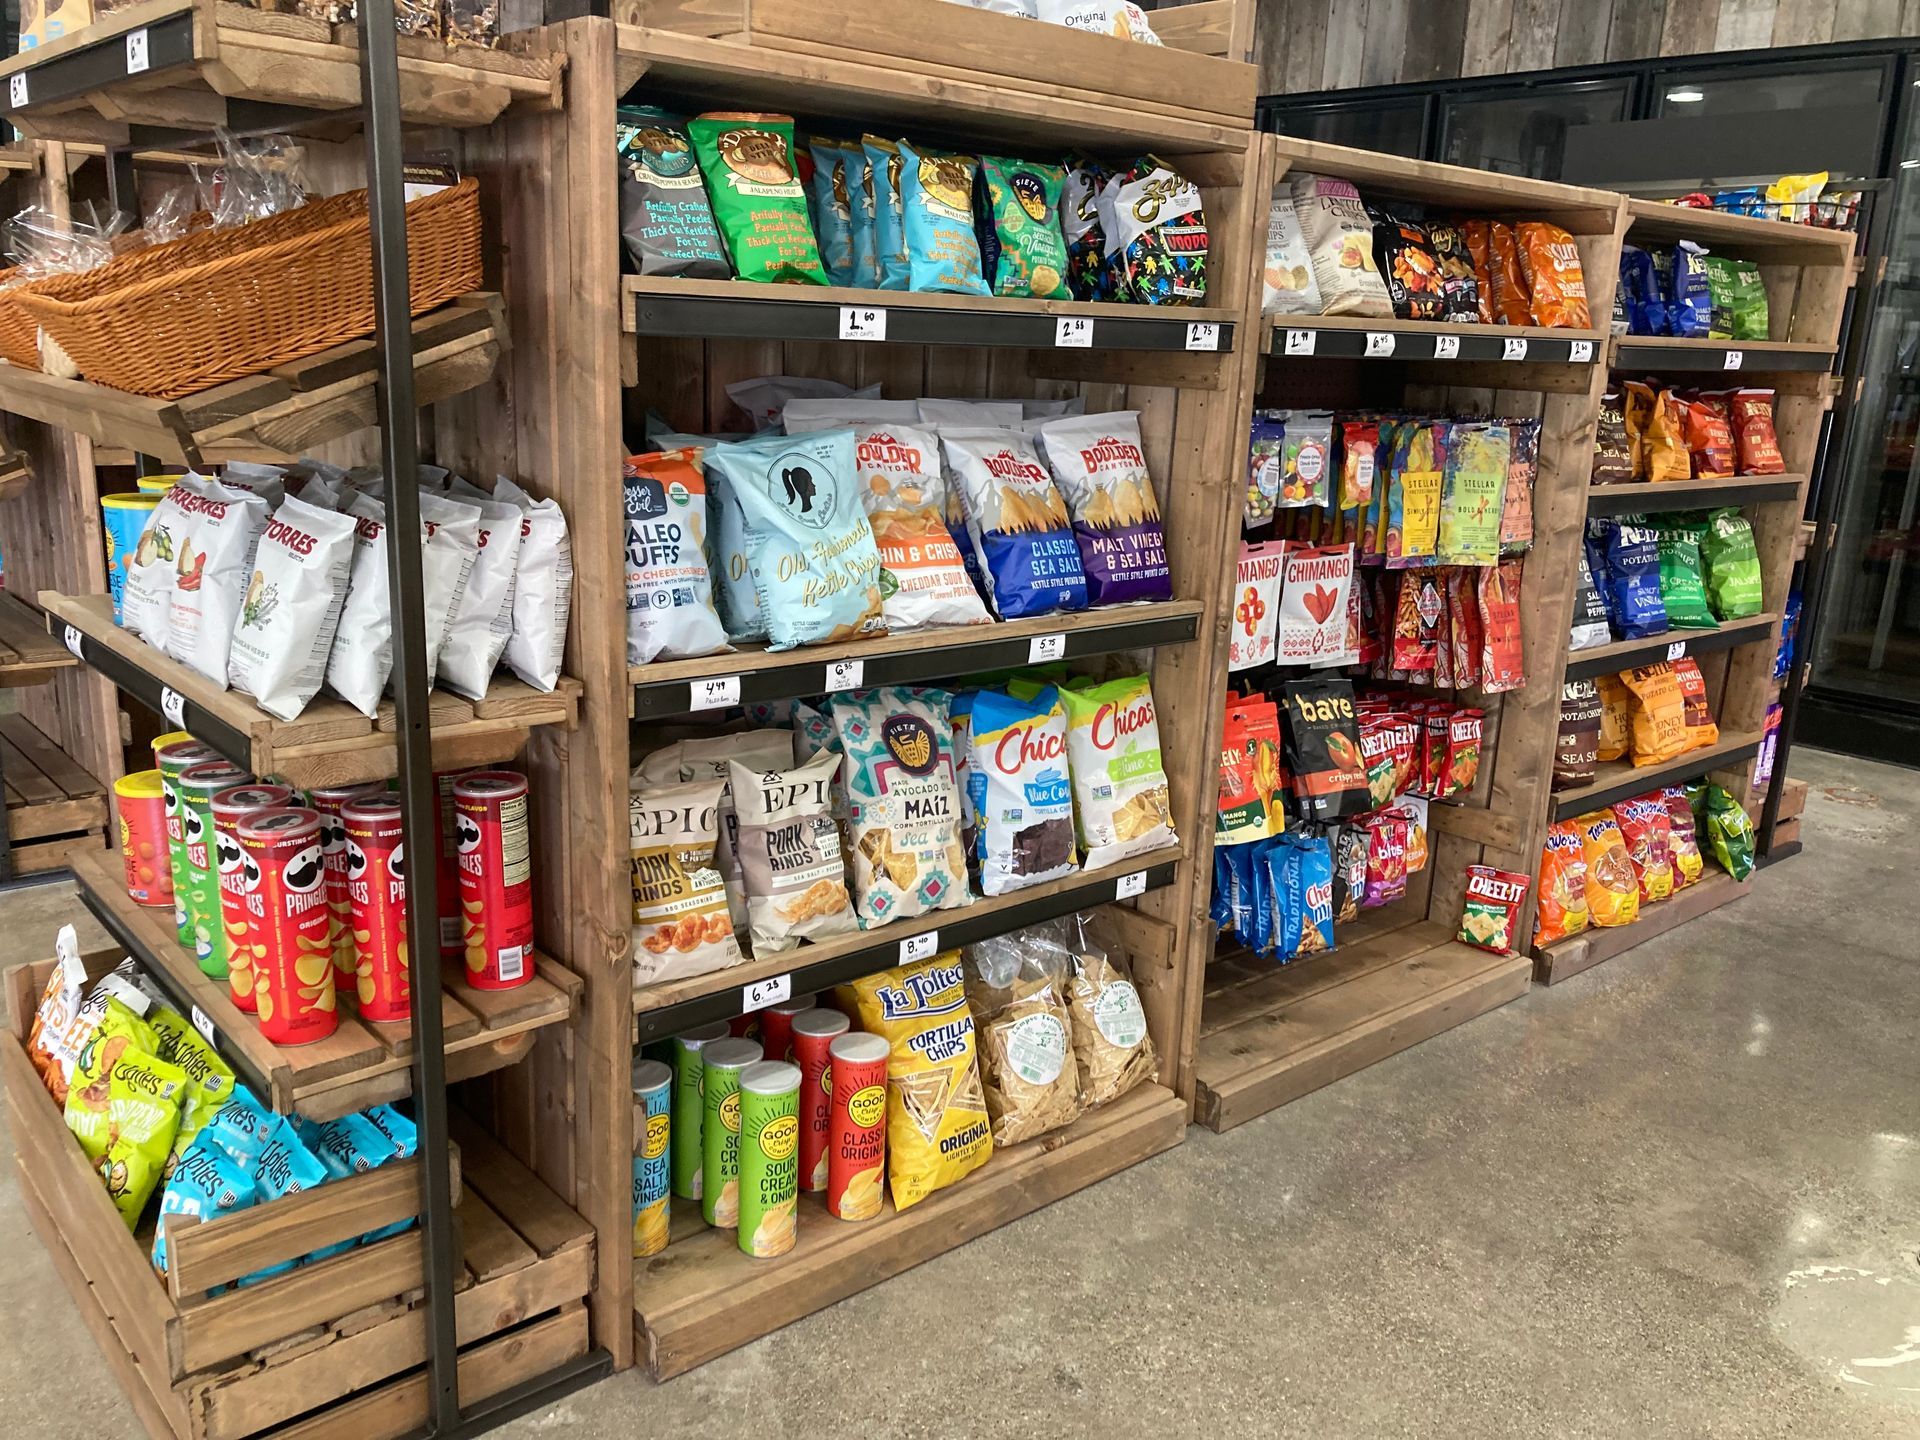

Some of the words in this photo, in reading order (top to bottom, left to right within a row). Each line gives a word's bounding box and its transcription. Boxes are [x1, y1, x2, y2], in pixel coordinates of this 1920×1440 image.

[1065, 12, 1106, 27] Original
[1015, 178, 1040, 193] SIETE
[645, 200, 677, 215] Artfully
[678, 201, 709, 212] Crafted
[649, 212, 685, 226] Partially
[640, 225, 669, 239] Thick
[675, 236, 692, 247] For
[691, 237, 708, 248] The
[1079, 444, 1145, 474] BOULDER
[1099, 461, 1134, 472] CANYON
[983, 457, 1048, 483] BOULDER
[1408, 480, 1439, 489] STELLAR
[1463, 480, 1495, 489] STELLAR
[263, 518, 319, 556] TORRES
[624, 523, 682, 546] ALEO
[908, 545, 921, 562] &
[1031, 539, 1076, 557] CLASSIC
[1092, 538, 1125, 554] MALT
[1031, 559, 1056, 576] SEA
[1059, 557, 1081, 573] SALT
[1106, 554, 1116, 570] &
[1121, 552, 1143, 569] SEA
[1144, 548, 1167, 566] SALT
[1111, 572, 1131, 582] KETTLE
[1130, 570, 1144, 580] STYLE
[1158, 567, 1169, 576] CHIPS
[1287, 557, 1351, 584] CHIMANGO
[802, 570, 849, 607] Kettle
[899, 573, 942, 592] CHEDDAR
[943, 570, 963, 585] SOUR
[1031, 579, 1050, 590] KETTLE
[1050, 578, 1064, 587] STYLE
[1685, 682, 1700, 692] CUT
[1295, 694, 1355, 723] bare
[890, 724, 916, 735] SIETE
[1091, 700, 1154, 751] Chicas
[1561, 752, 1585, 765] SEA
[760, 780, 832, 815] EPI
[893, 783, 939, 797] AVOCADO
[464, 805, 488, 813] FLAVOR
[904, 795, 950, 820] MAÍZ
[1034, 808, 1059, 816] TORTILLA
[631, 807, 718, 838] EPIC
[1222, 811, 1248, 821] MANGO
[1225, 818, 1247, 826] halves
[893, 822, 914, 830] CORN
[915, 819, 945, 828] TORTILLA
[349, 830, 373, 838] FLAVOR
[766, 823, 808, 857] PORK
[1377, 844, 1404, 859] bits
[769, 851, 814, 871] RINDS
[806, 870, 821, 878] SALT
[632, 880, 684, 904] RINDS
[1286, 855, 1300, 942] TRADITIONAL
[680, 896, 714, 909] SEASONING
[902, 965, 921, 975] SANTA
[877, 987, 912, 1019] La
[907, 1016, 974, 1052] TORTILLA
[209, 1074, 222, 1086] UP
[852, 1093, 885, 1108] GOOD
[861, 1107, 879, 1115] Crisp
[647, 1122, 670, 1138] OOD
[764, 1123, 797, 1141] GOOD
[778, 1122, 789, 1130] The
[771, 1137, 791, 1147] Crisp
[940, 1119, 989, 1154] ORIGINAL
[946, 1147, 970, 1162] LIGHTLY
[971, 1137, 988, 1151] SALTED
[255, 1140, 292, 1191] Uglies
[356, 1157, 370, 1169] UP
[644, 1160, 666, 1175] SEA
[765, 1156, 796, 1177] SOUR
[174, 1146, 225, 1198] Uglies
[634, 1175, 663, 1192] SALT
[760, 1170, 798, 1192] CREAM
[223, 1190, 237, 1203] UP
[760, 1194, 768, 1205] &
[770, 1186, 798, 1205] ONION
